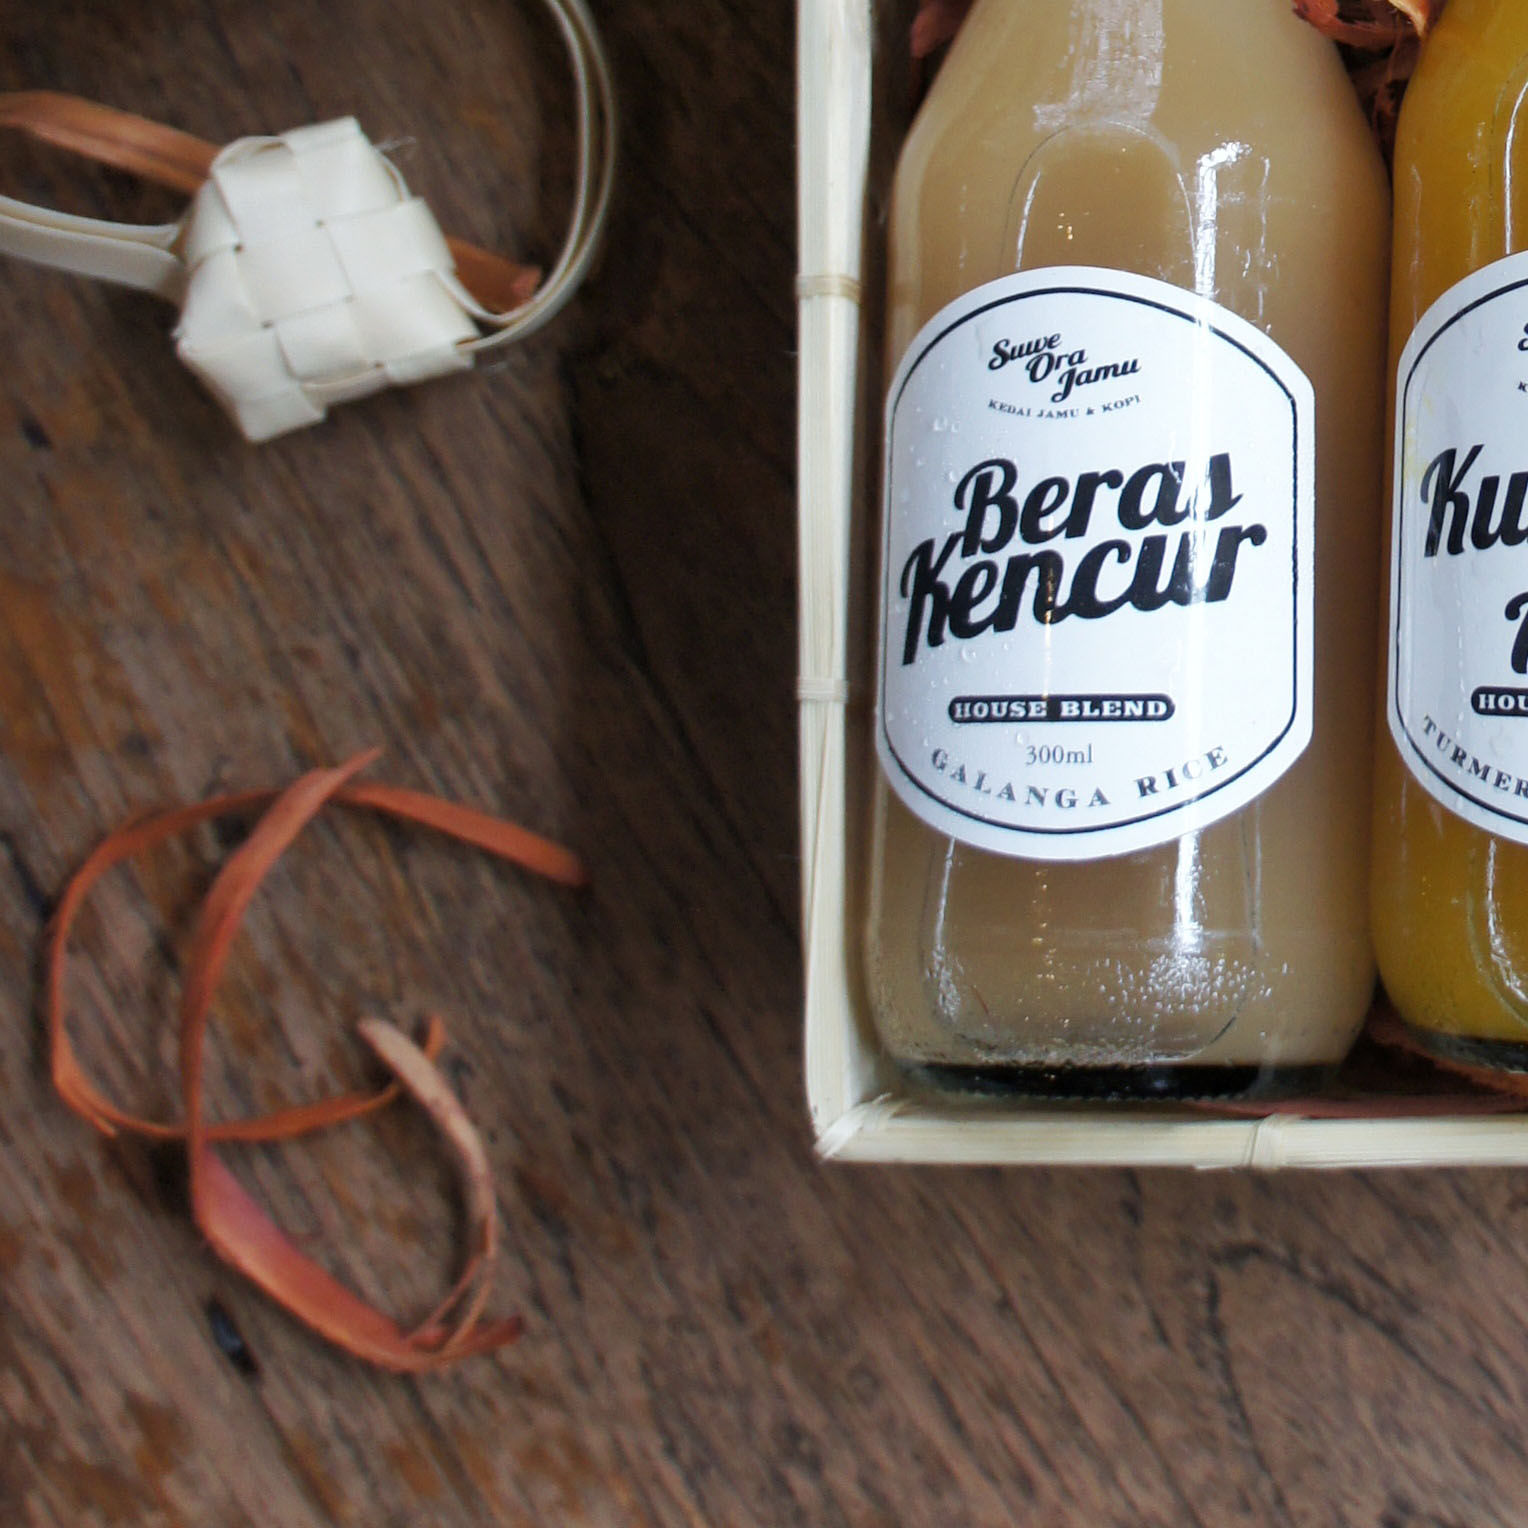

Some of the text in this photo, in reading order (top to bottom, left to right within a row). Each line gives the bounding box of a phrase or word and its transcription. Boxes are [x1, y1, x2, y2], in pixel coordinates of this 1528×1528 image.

[988, 333, 1062, 370] Suwe
[1026, 349, 1087, 383] Ora
[1051, 359, 1141, 403] Jamu
[988, 394, 1141, 419] KEDAI JAMU & KOPI
[954, 453, 1244, 558] Beras
[901, 523, 1267, 666] Kencur
[954, 699, 1168, 718] HOUSE BLEND
[1026, 743, 1093, 765] 300ml
[931, 745, 1229, 809] GALANGA RICE
